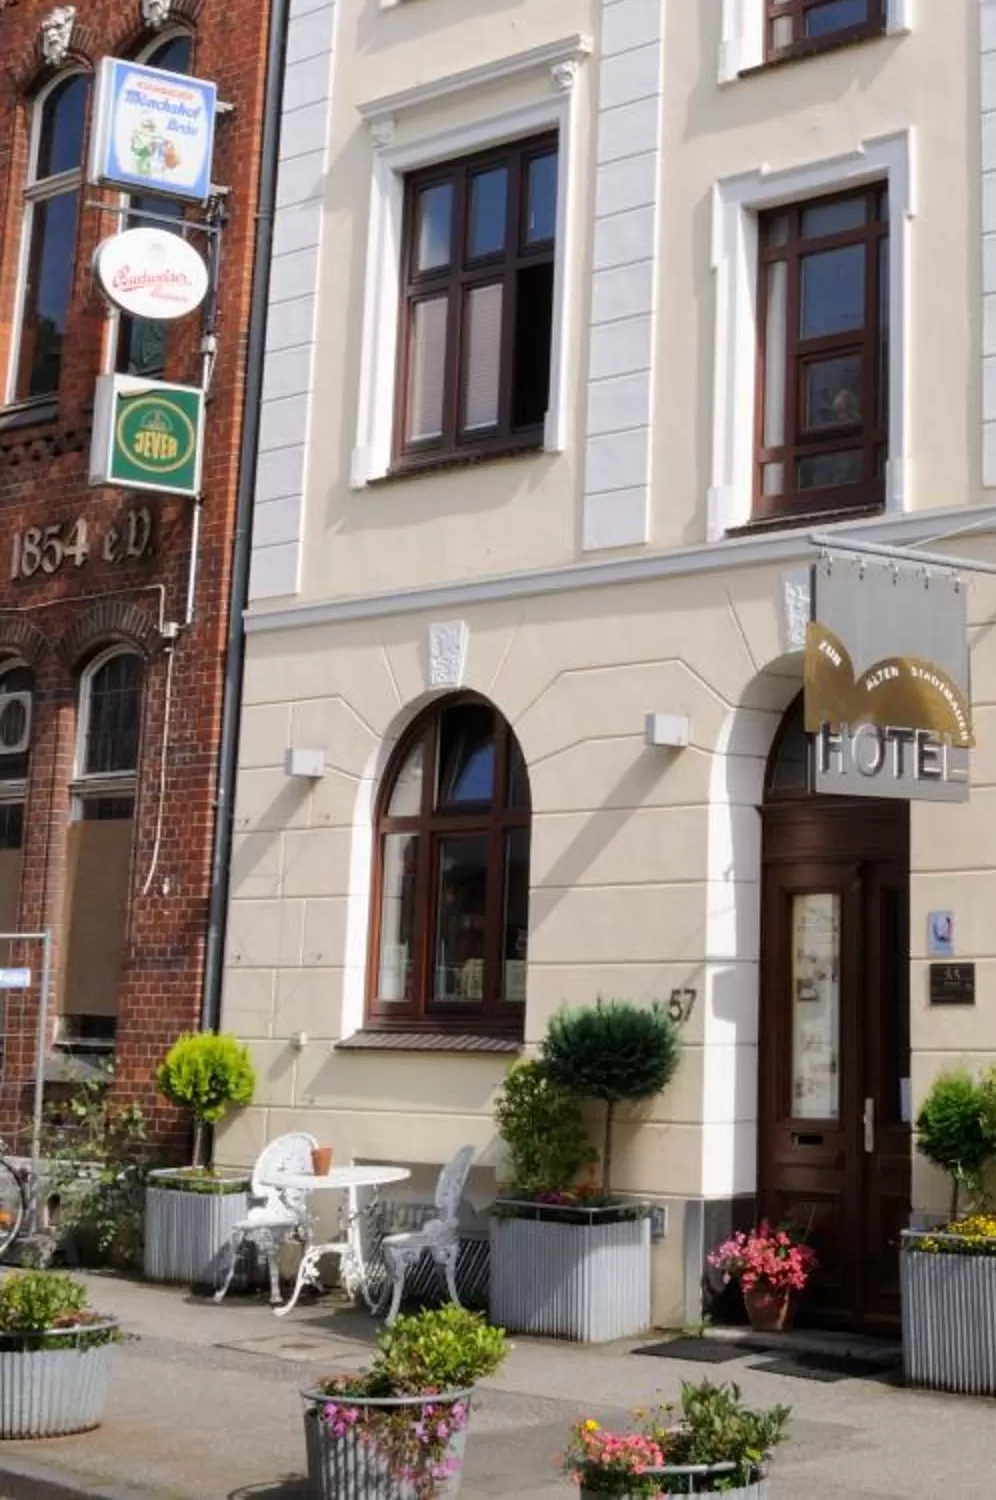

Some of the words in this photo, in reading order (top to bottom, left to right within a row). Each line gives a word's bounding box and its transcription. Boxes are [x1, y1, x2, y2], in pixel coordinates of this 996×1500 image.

[133, 430, 178, 461] JEVER
[10, 516, 90, 581] 1854
[864, 664, 899, 693] ALTEN
[818, 721, 968, 782] HOTEL
[668, 987, 697, 1023] 57
